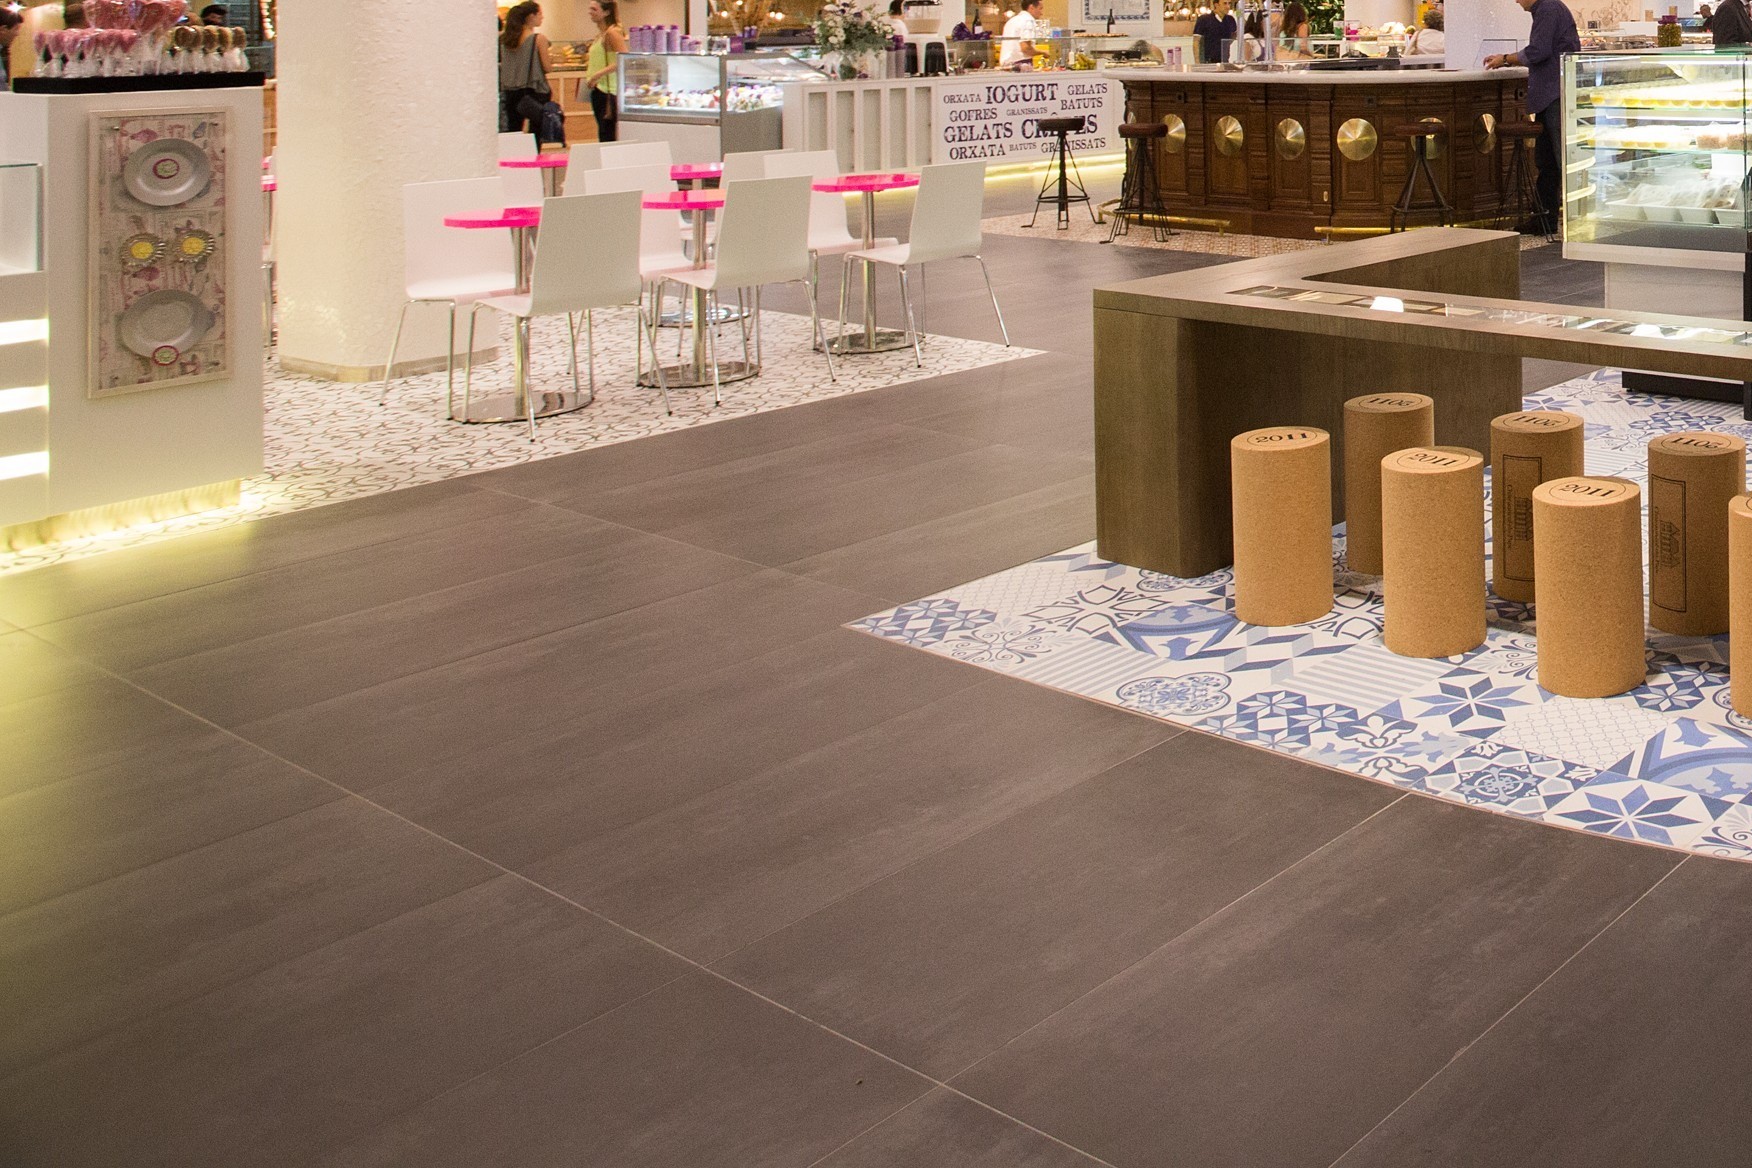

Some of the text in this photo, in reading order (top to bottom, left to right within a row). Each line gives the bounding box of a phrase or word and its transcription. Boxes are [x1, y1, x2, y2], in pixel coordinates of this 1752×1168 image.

[943, 83, 1108, 105] ORXATA IOGURT GELATS
[950, 97, 1103, 123] GOFRES GRANISSATS BATUTS
[943, 121, 1013, 144] GELATS
[949, 143, 1006, 160] ORXATA
[1009, 142, 1037, 152] BATUTS
[1255, 431, 1308, 443] 2011
[1407, 452, 1459, 467] 2011
[1558, 483, 1617, 497] 2011
